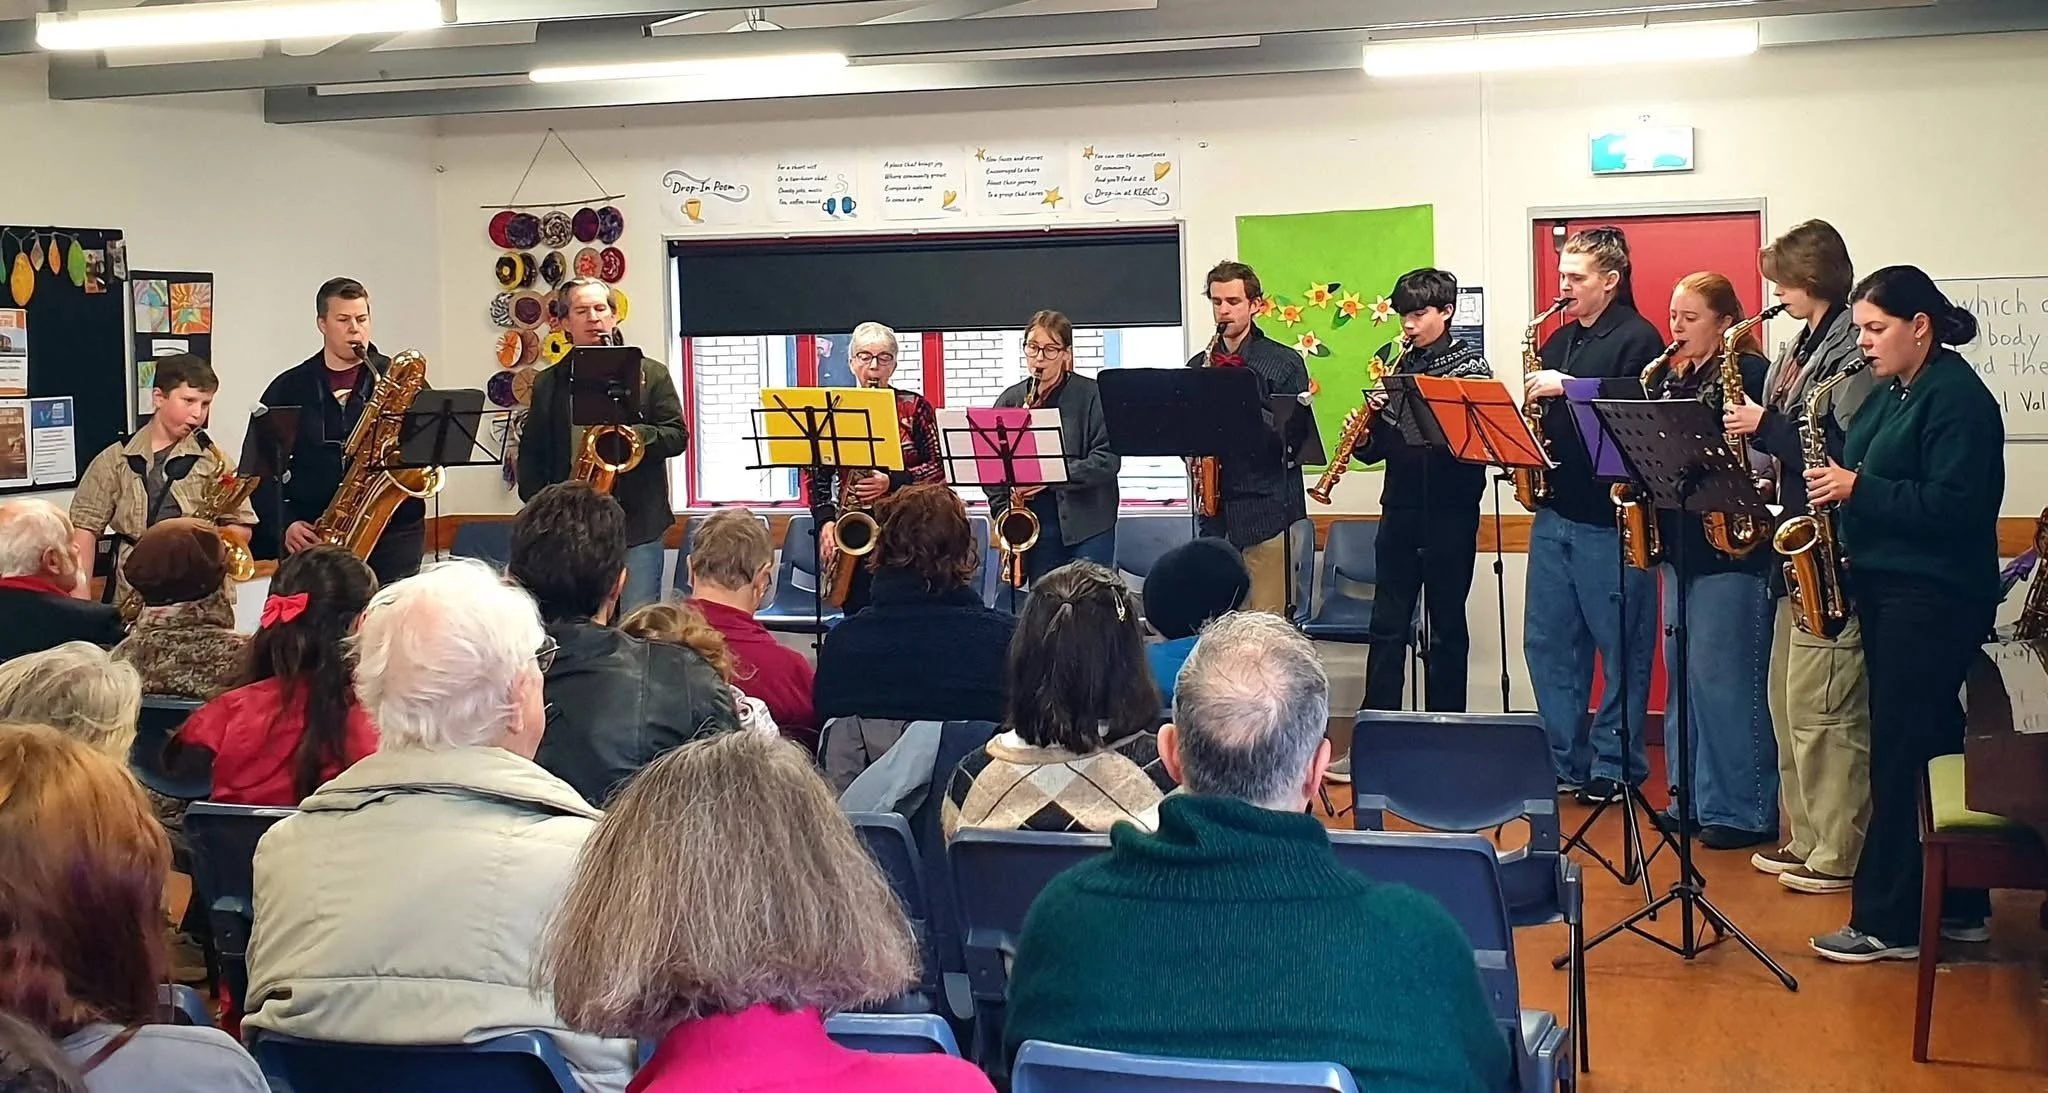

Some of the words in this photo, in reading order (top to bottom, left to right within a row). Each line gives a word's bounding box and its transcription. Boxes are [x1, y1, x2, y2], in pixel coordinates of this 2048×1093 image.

[672, 181, 711, 194] Drop-In
[713, 181, 736, 192] Poem
[1094, 188, 1122, 198] Drop-in
[1955, 284, 2028, 316] which
[1987, 321, 2041, 363] body
[1973, 356, 1996, 375] nd
